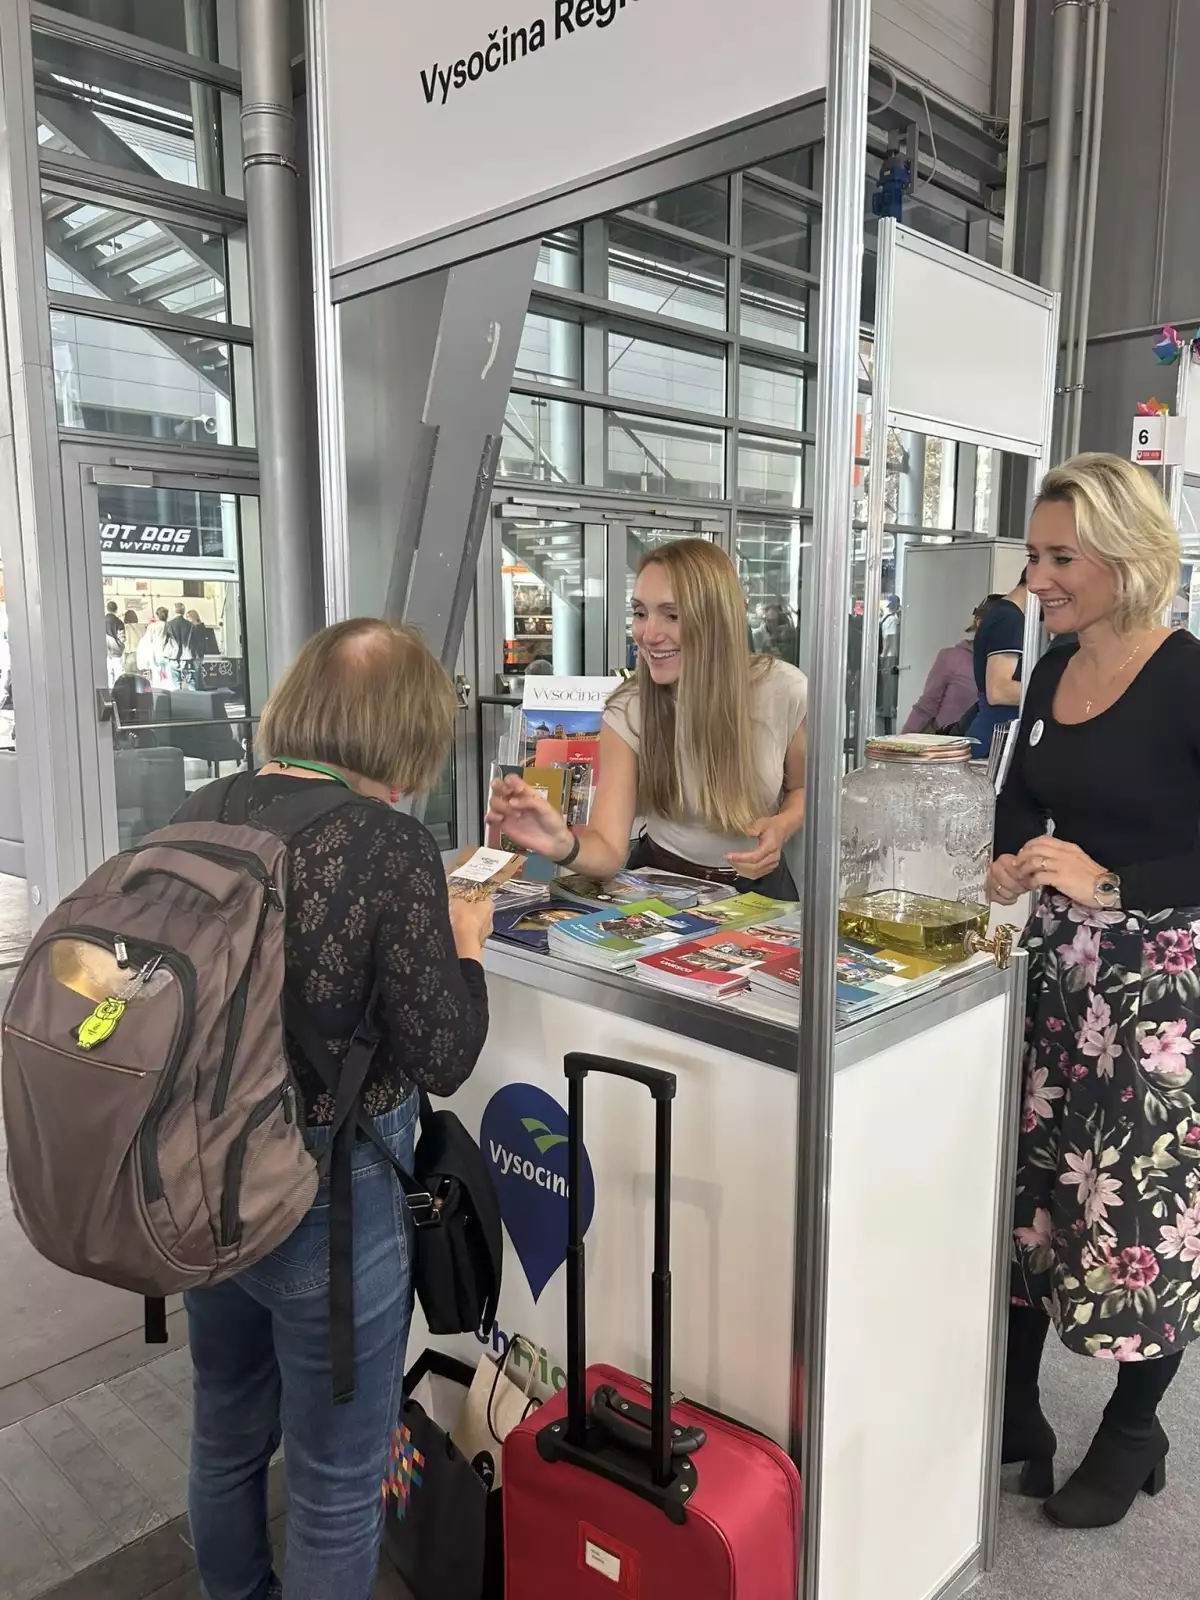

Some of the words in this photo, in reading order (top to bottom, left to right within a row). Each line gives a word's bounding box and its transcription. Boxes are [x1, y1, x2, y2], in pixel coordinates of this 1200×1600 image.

[420, 18, 546, 106] Vysočina
[1138, 428, 1149, 446] 6
[140, 526, 192, 543] DOG
[532, 687, 601, 704] Vysočina
[489, 1139, 569, 1199] Vysocin
